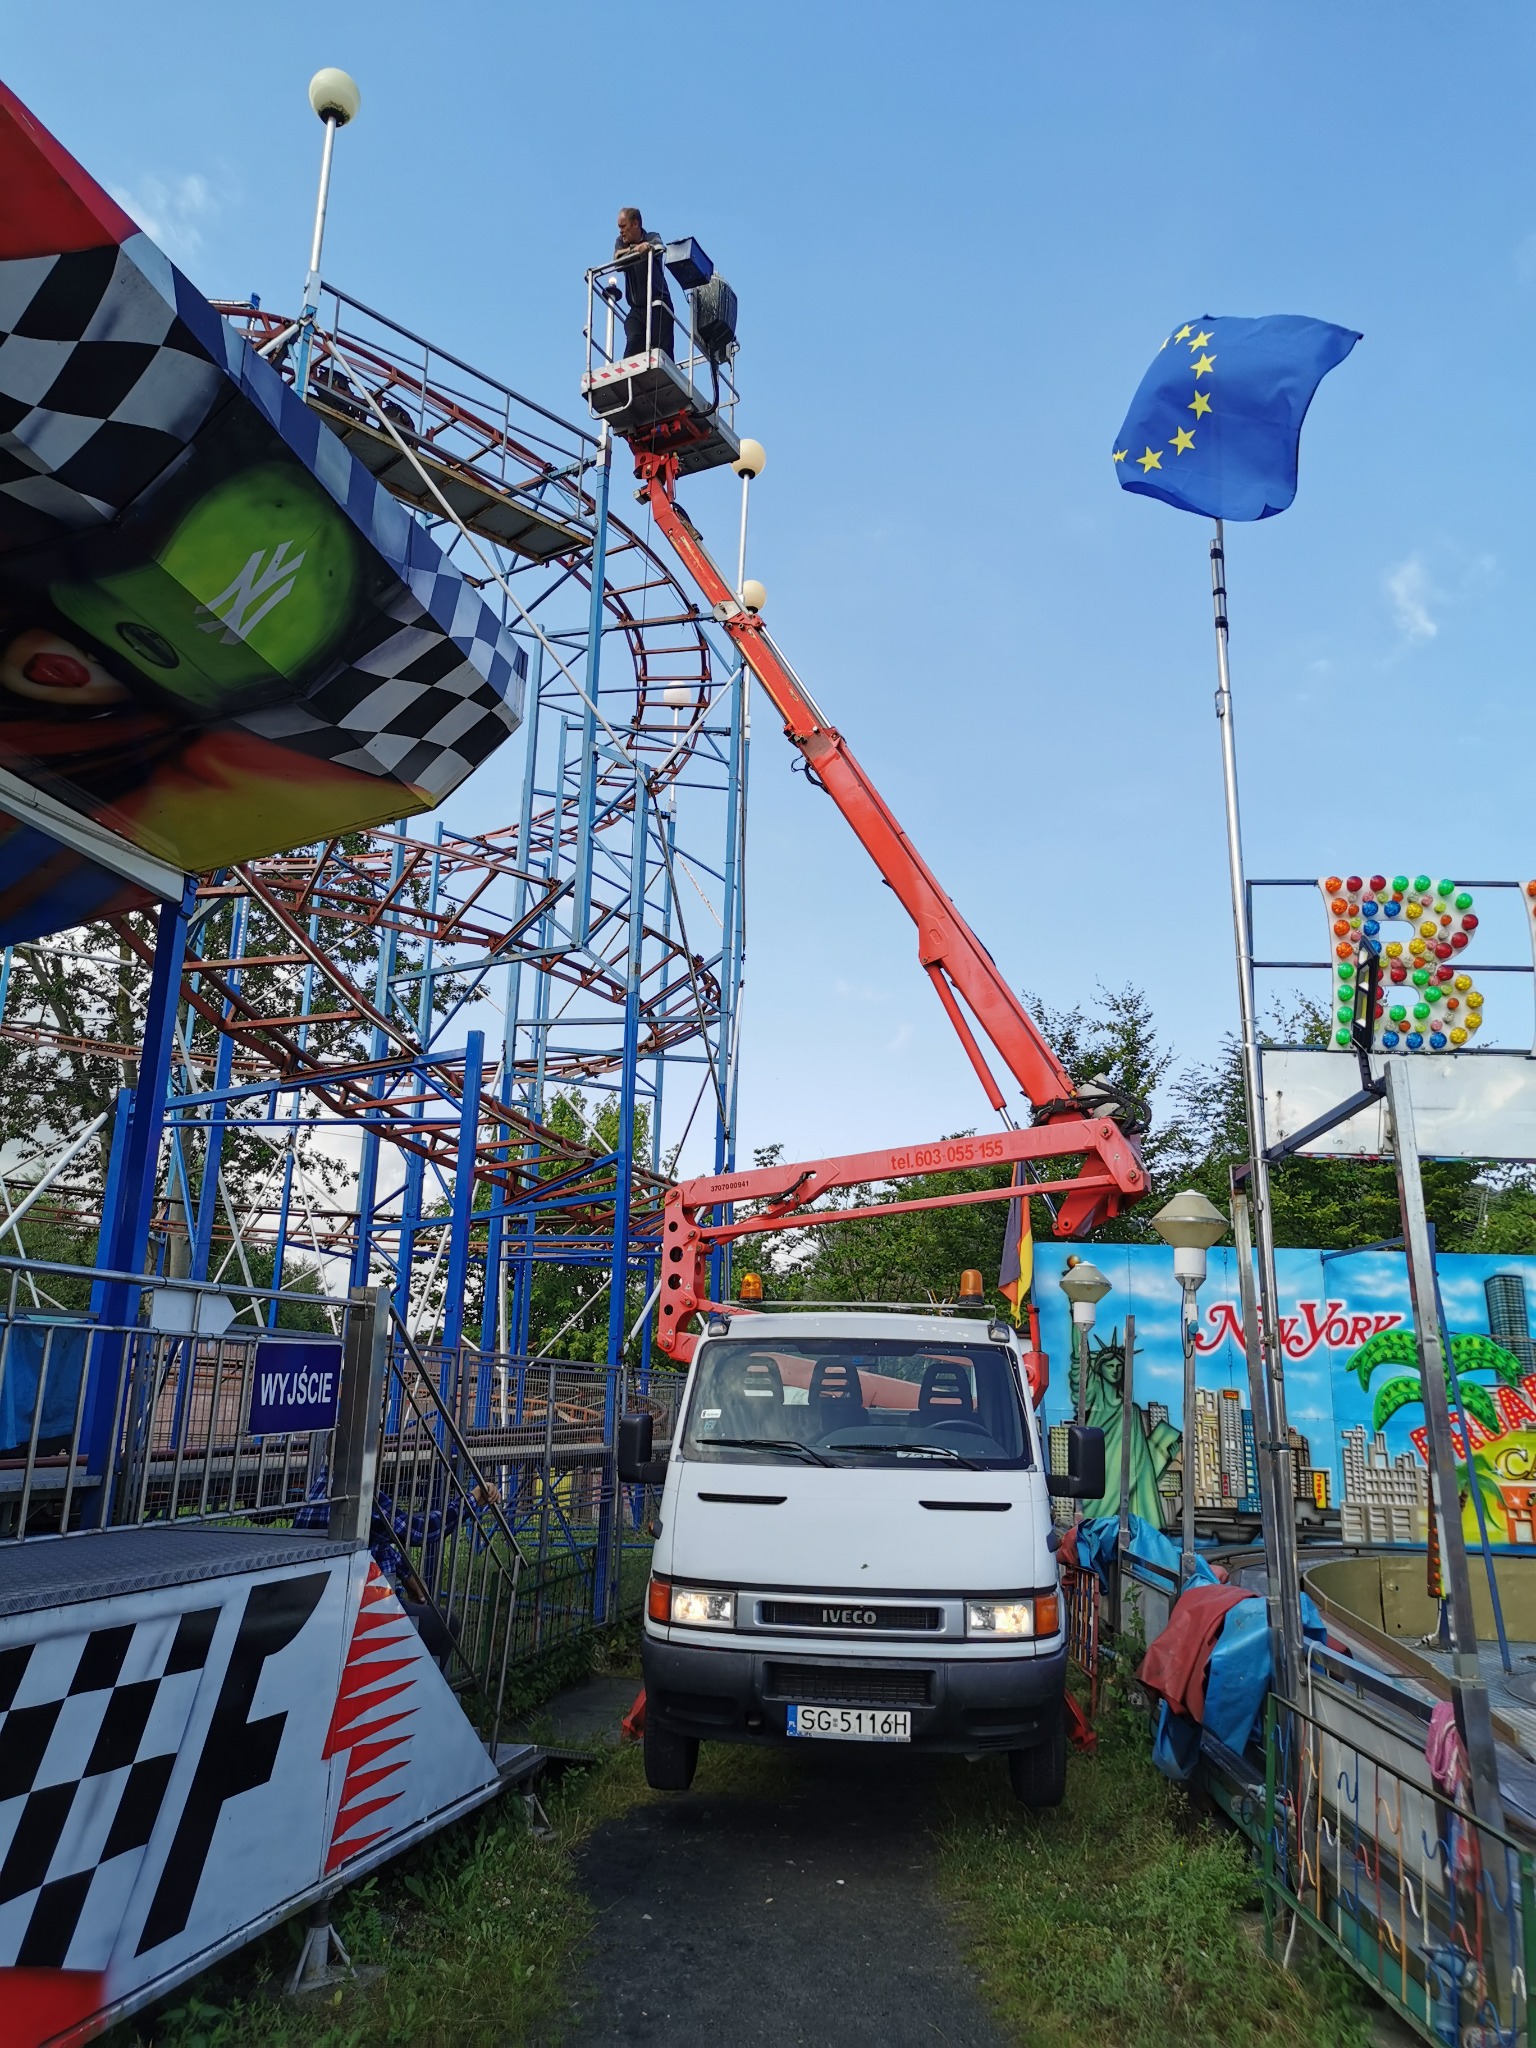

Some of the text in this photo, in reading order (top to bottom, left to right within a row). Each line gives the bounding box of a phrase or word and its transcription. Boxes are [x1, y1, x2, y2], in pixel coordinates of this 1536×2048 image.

[1318, 876, 1536, 1055] B
[710, 1180, 749, 1193] 3707000941
[261, 1365, 333, 1406] WYJŚCIE
[822, 1609, 877, 1625] IVECO
[801, 1709, 907, 1734] SG 5116H
